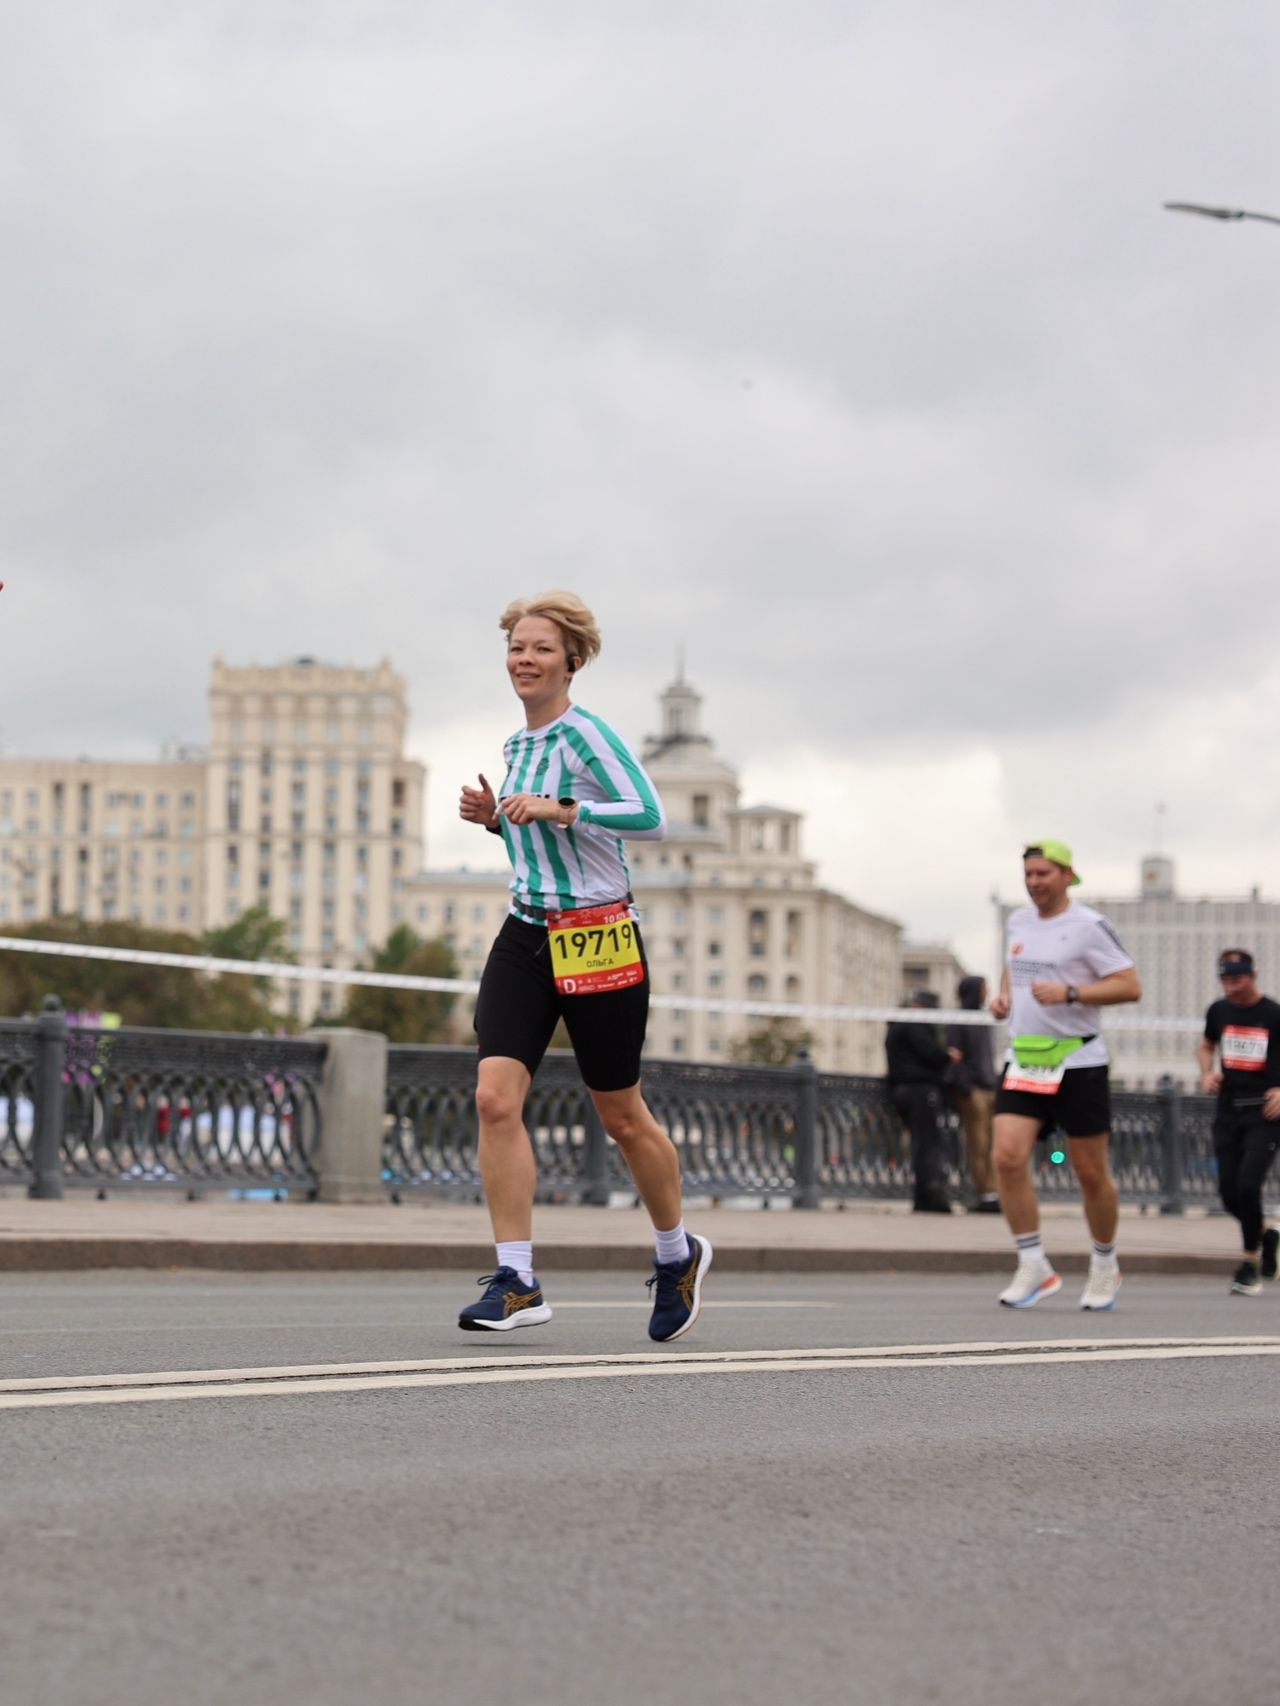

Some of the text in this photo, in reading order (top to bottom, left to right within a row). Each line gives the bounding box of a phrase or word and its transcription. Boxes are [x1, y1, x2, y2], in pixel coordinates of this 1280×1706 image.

[604, 915, 615, 924] 10
[555, 924, 632, 960] 19719
[586, 958, 615, 968] ОЛЬГА
[563, 979, 577, 994] D
